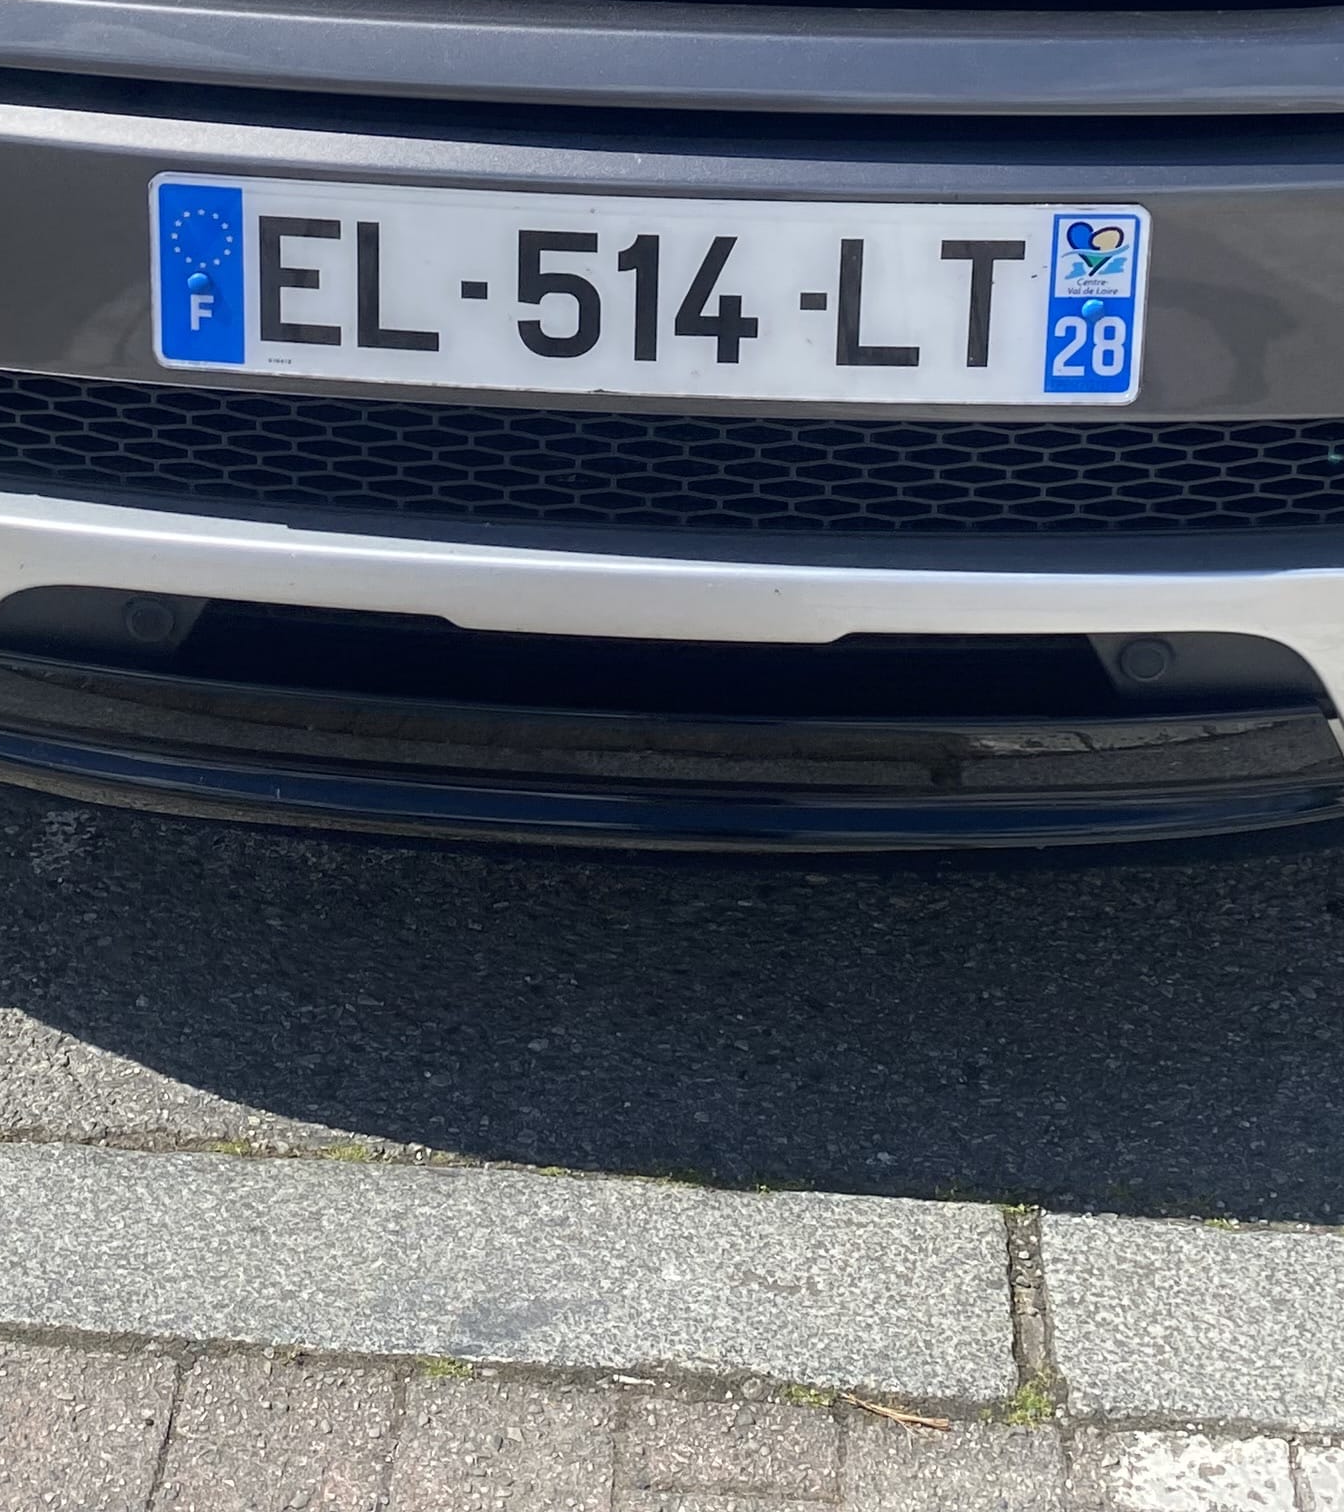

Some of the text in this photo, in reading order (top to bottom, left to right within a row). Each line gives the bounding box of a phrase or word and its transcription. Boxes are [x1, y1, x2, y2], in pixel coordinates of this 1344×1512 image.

[1067, 287, 1119, 296] Val de Loire
[190, 294, 214, 331] F
[1052, 316, 1127, 377] 28
